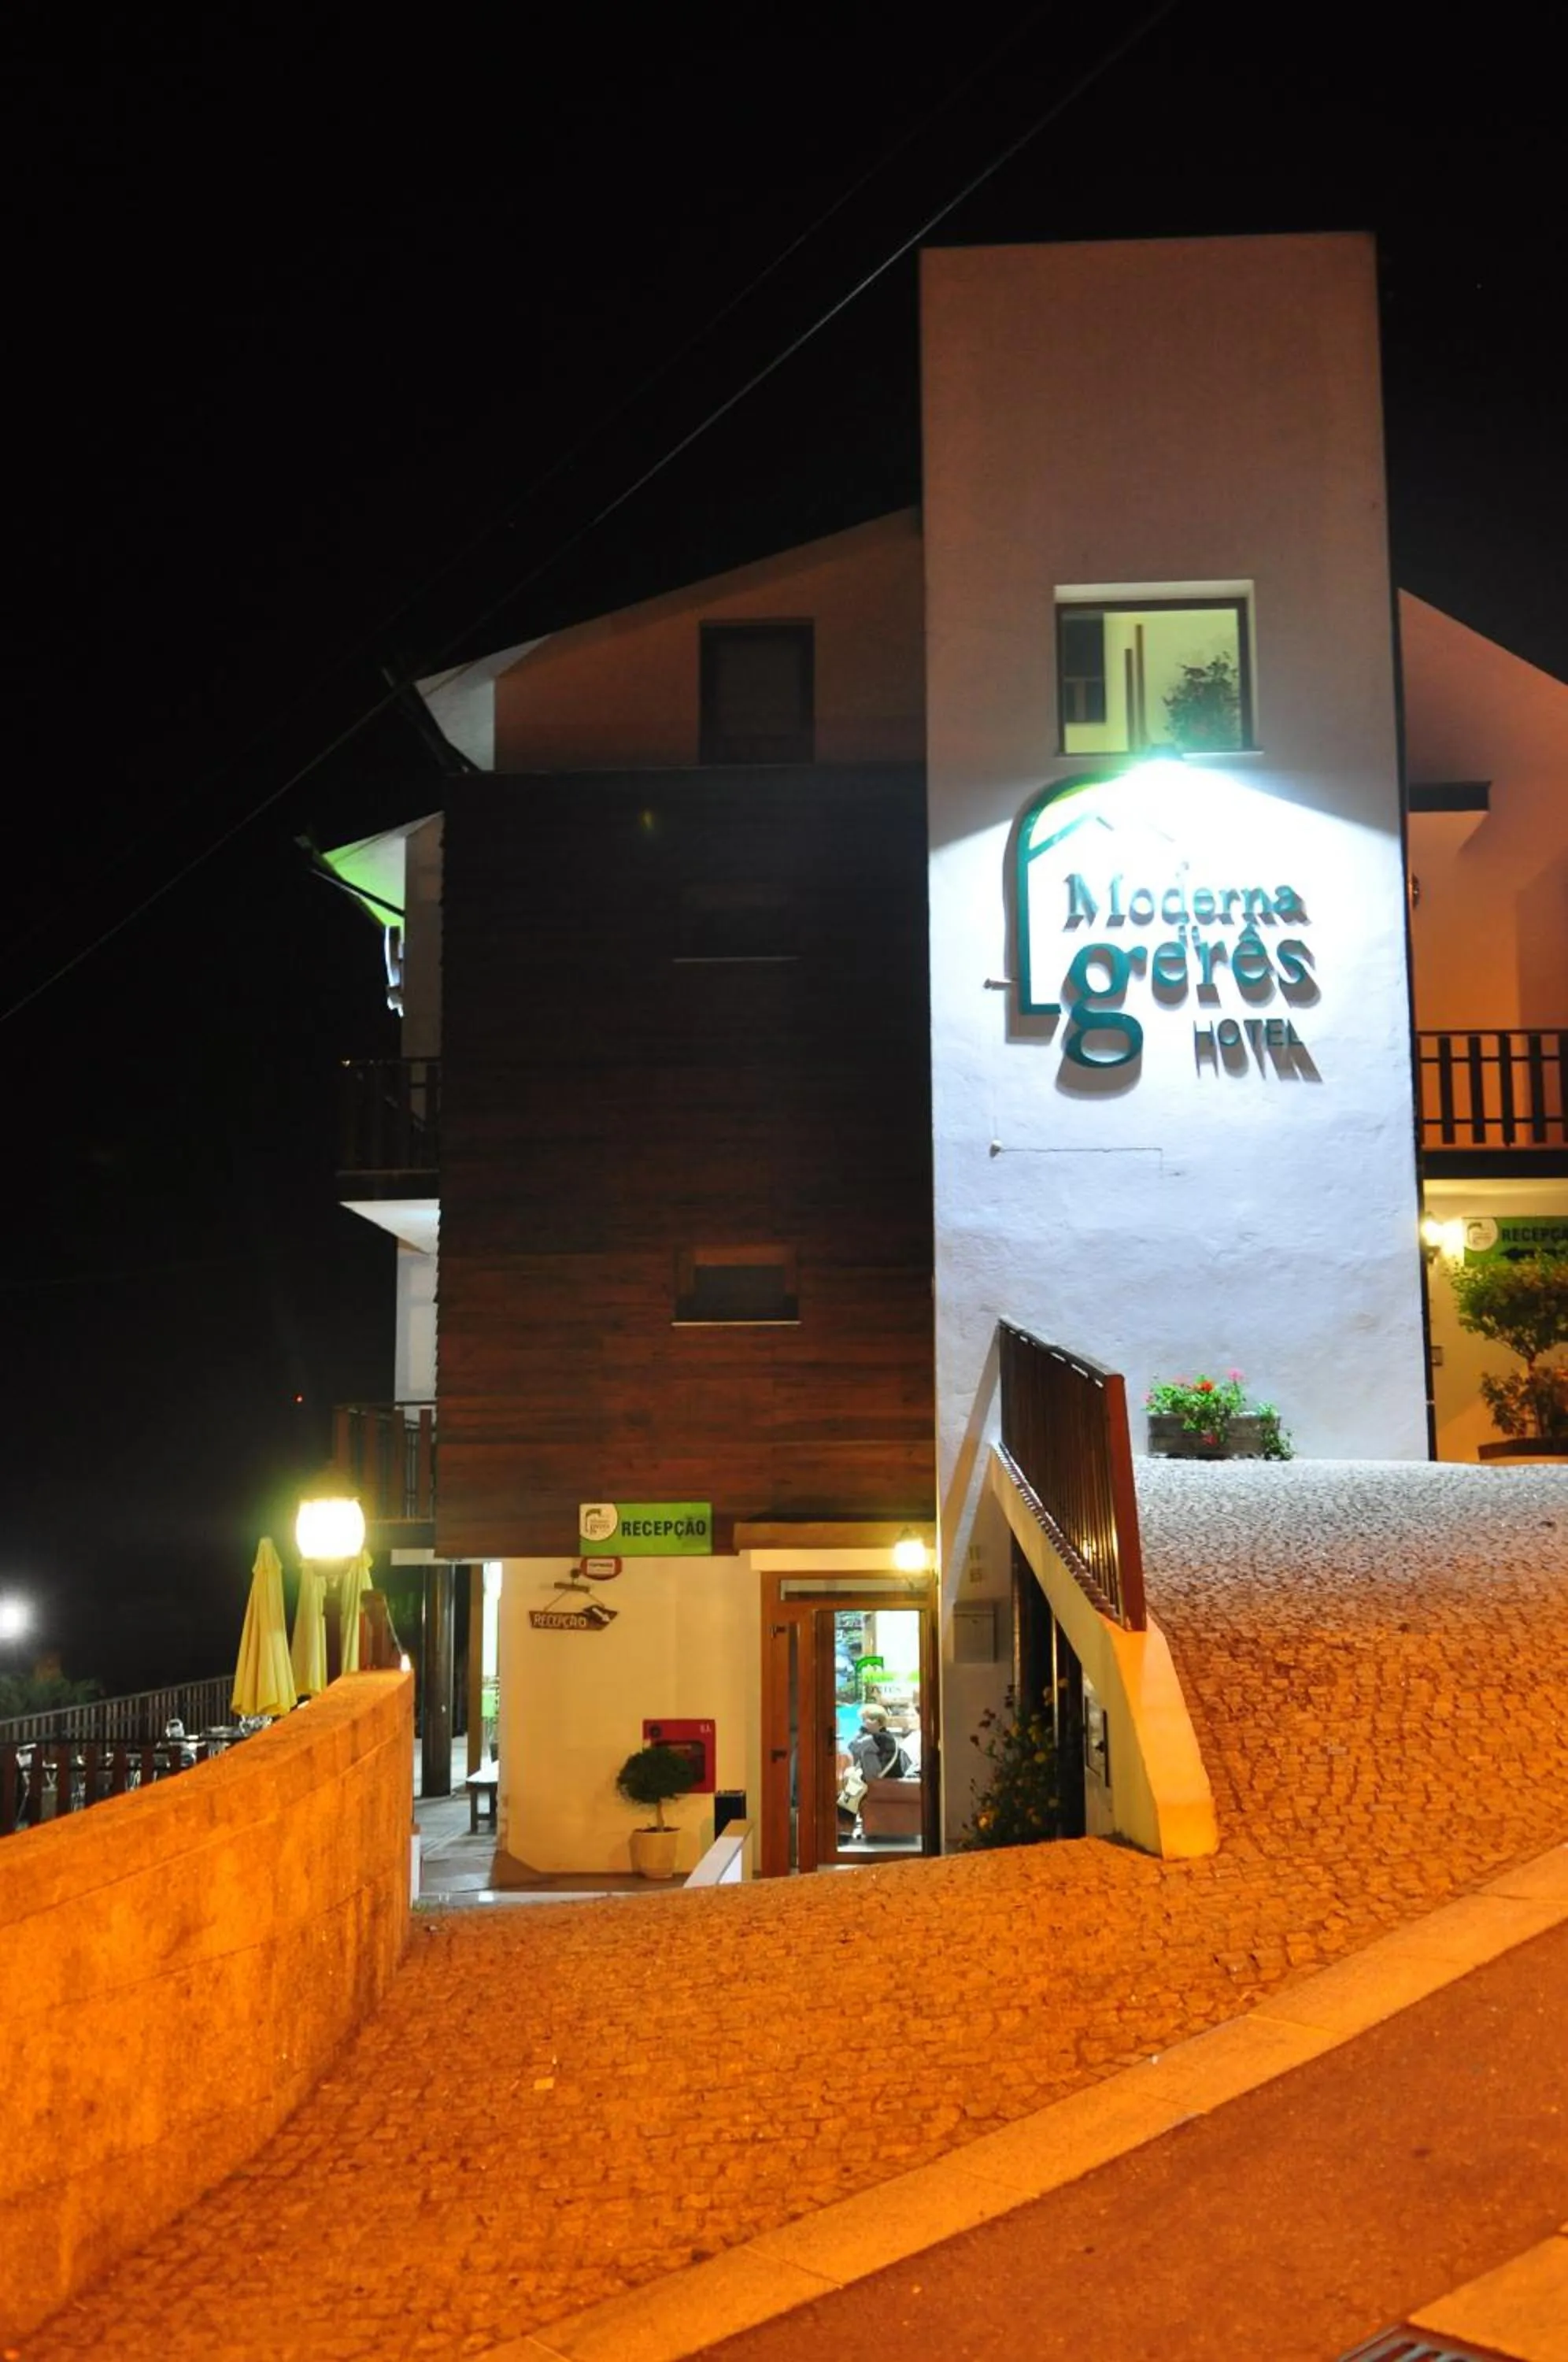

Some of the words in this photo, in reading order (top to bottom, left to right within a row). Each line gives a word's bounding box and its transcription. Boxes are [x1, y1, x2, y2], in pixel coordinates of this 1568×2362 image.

[1063, 872, 1308, 924] Moderna
[1063, 924, 1310, 1068] gerês
[621, 1516, 706, 1540] RECEPÇÃO
